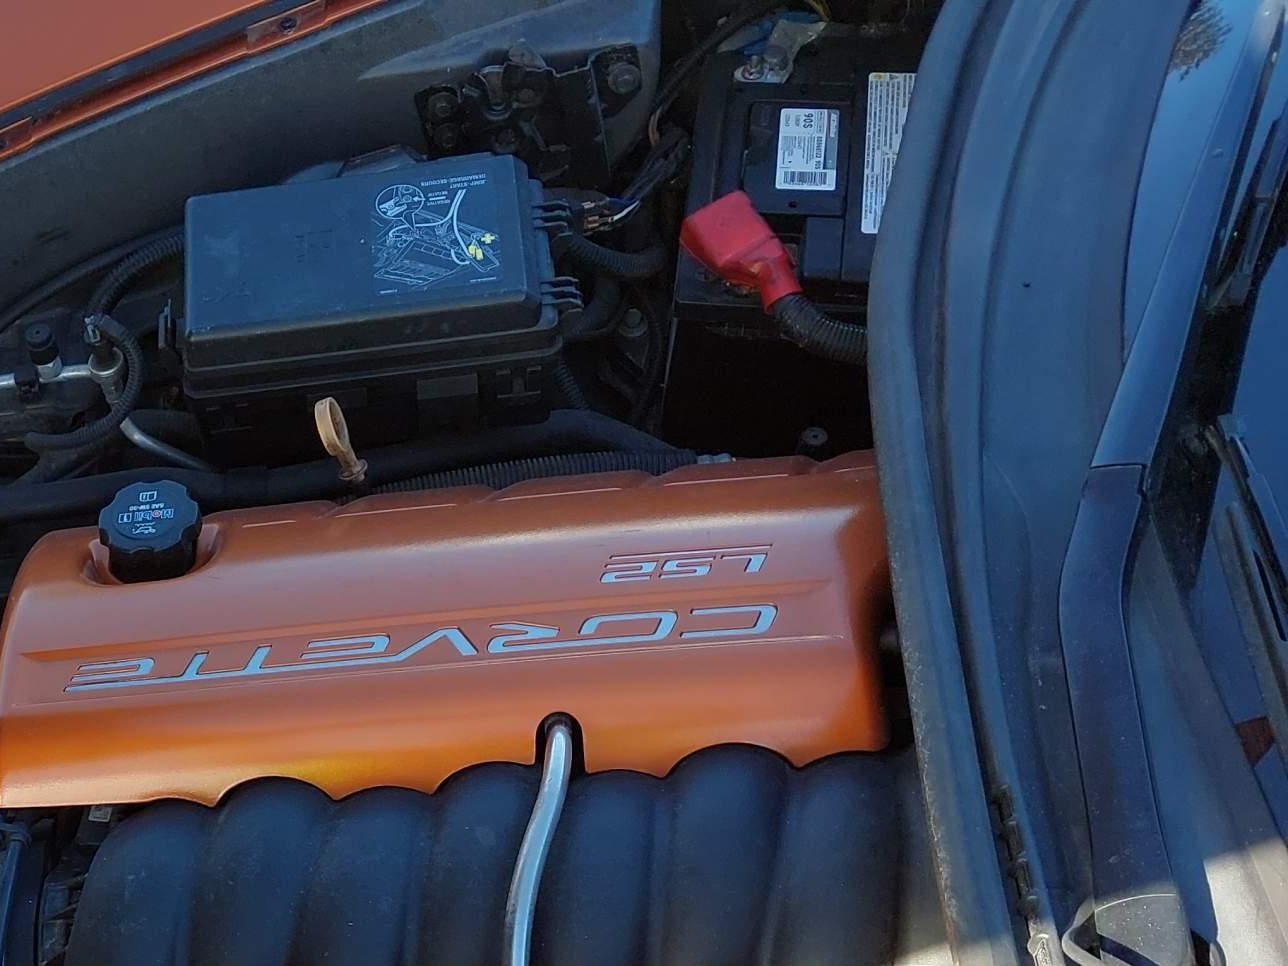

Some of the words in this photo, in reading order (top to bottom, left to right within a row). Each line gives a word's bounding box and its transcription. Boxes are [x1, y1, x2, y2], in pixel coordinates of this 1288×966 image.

[803, 113, 814, 129] 90S
[134, 508, 174, 522] Mobil
[600, 551, 769, 584] LS2
[64, 603, 778, 693] CORVETTE
